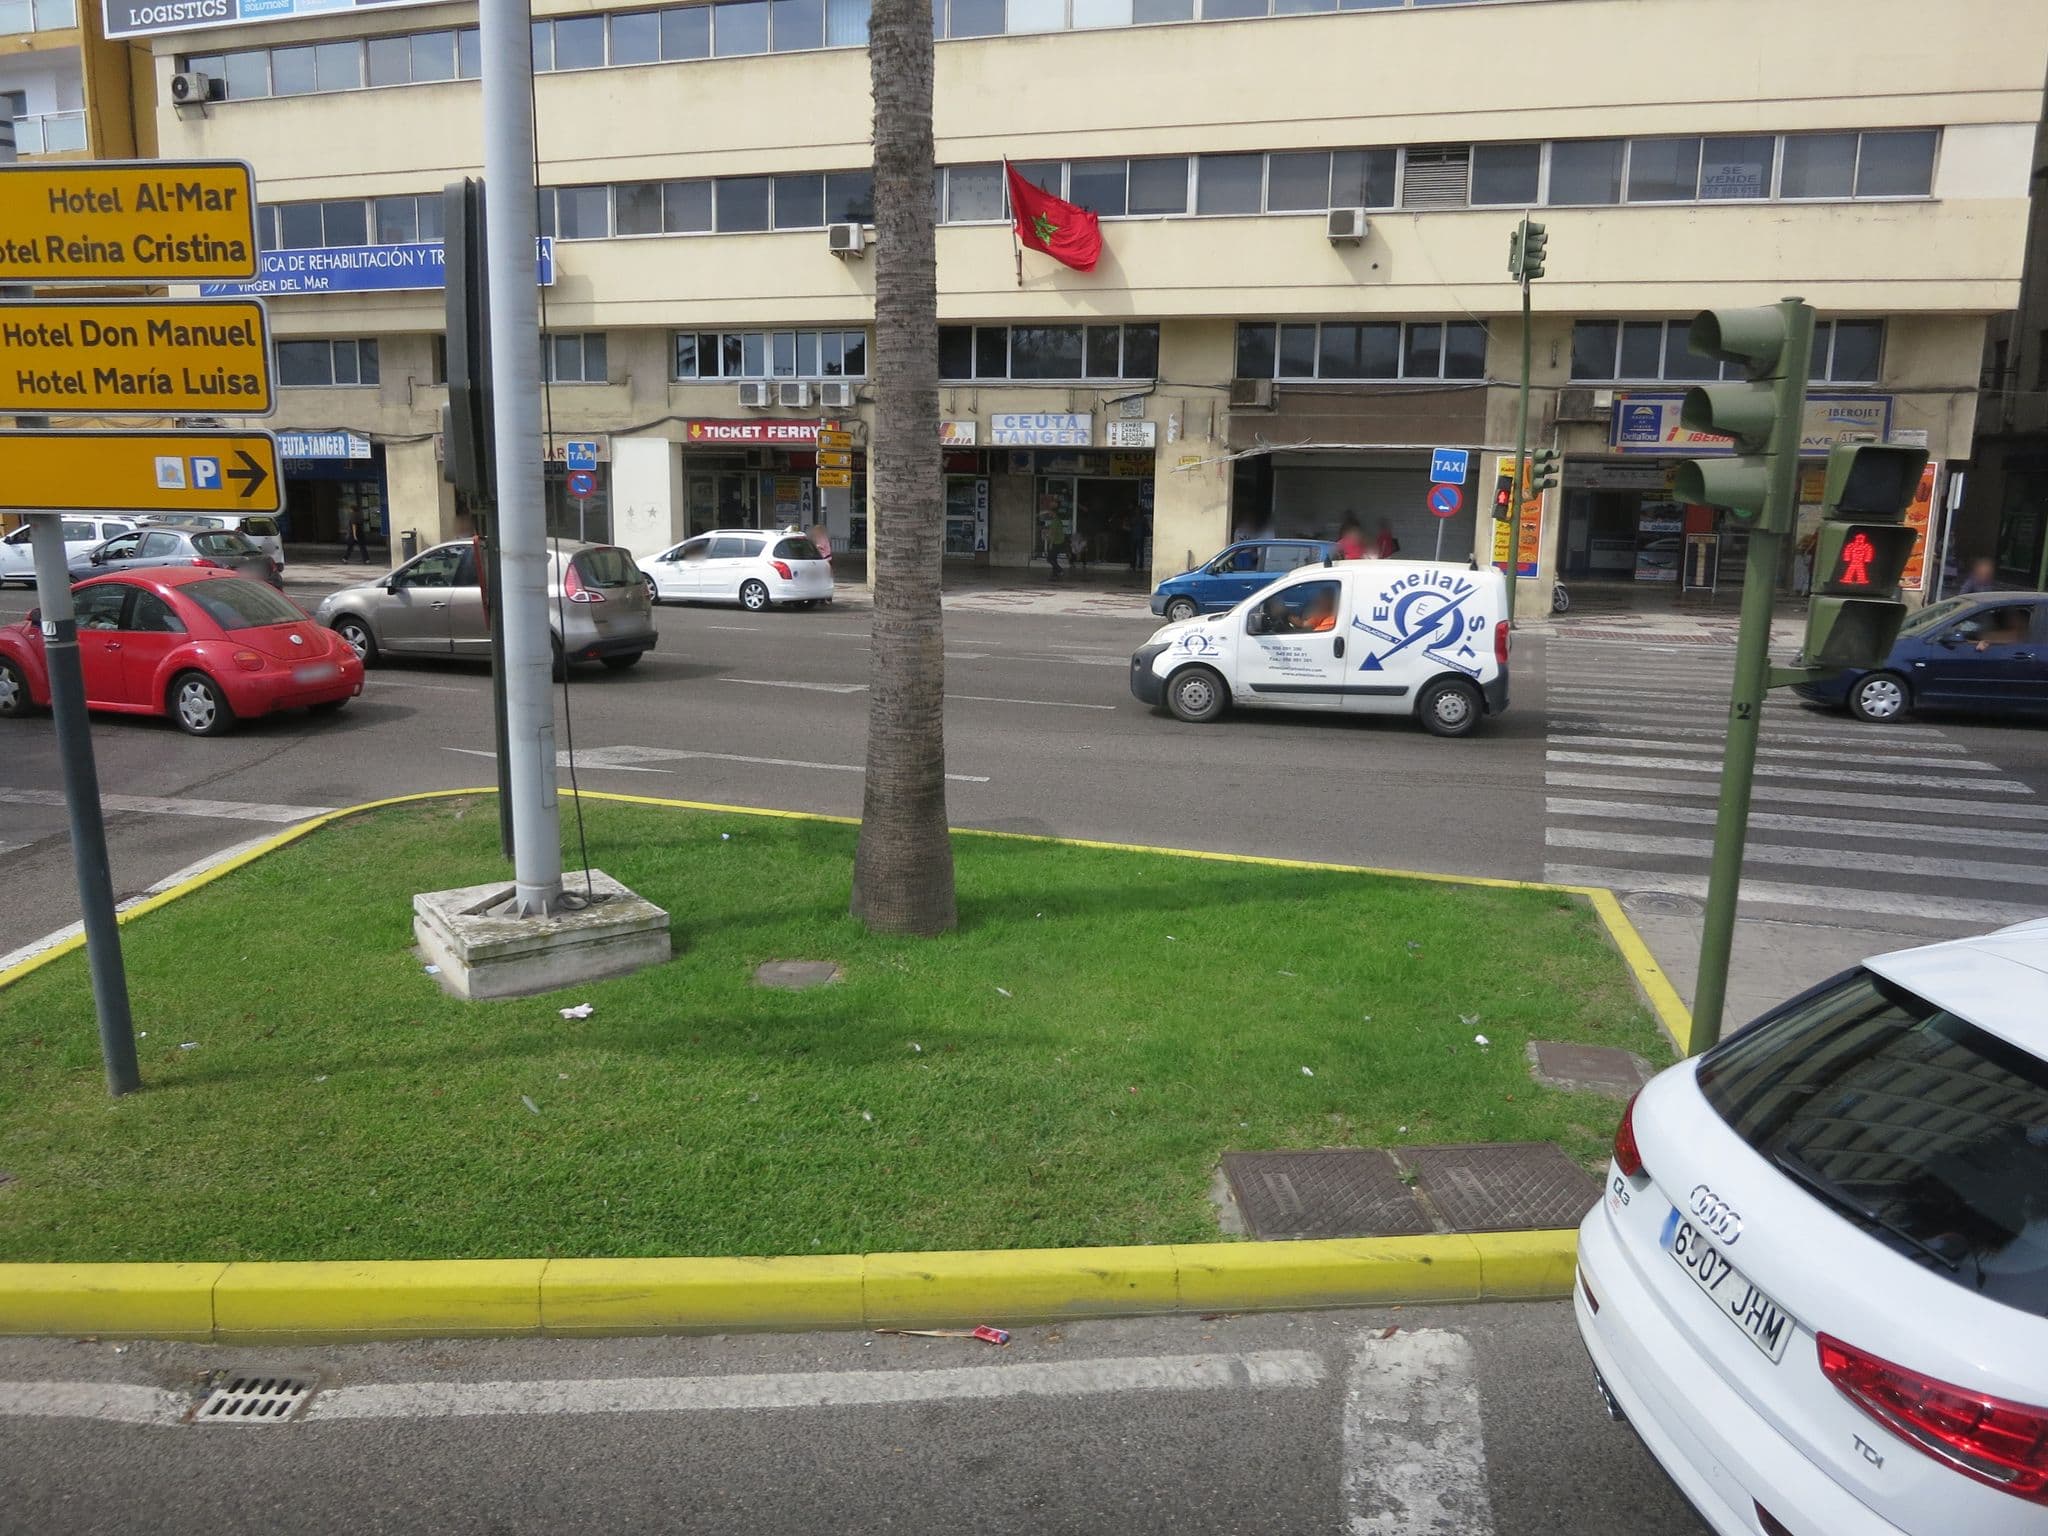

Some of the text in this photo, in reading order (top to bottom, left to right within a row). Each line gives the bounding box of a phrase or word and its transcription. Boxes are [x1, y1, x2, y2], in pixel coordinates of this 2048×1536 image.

[130, 0, 228, 26] LOGISTICS
[244, 0, 289, 13] SOLUTIONS
[1721, 166, 1742, 175] SE
[1705, 175, 1757, 184] VENDE
[48, 182, 237, 214] Hotel Al-Mar
[46, 234, 125, 264] Reina
[133, 233, 246, 263] Cristina
[289, 256, 305, 271] DE
[309, 246, 414, 271] REHABILITACIÓN
[417, 250, 426, 266] Y
[238, 280, 276, 292] VIRGEN
[280, 279, 299, 291] DEL
[3, 319, 256, 347] Hotel Don Manuel
[17, 366, 261, 395] Hotel María Luisa
[1828, 408, 1880, 417] IBEROJET
[1004, 415, 1078, 429] CEUTA
[704, 426, 821, 438] TICKET FERRY
[996, 430, 1088, 444] TANGER
[1434, 461, 1465, 473] TAXI
[977, 483, 986, 550] CELIA
[1736, 703, 1751, 720] 2
[1613, 1176, 1631, 1206] Q3
[1852, 1433, 1884, 1469] TDI
